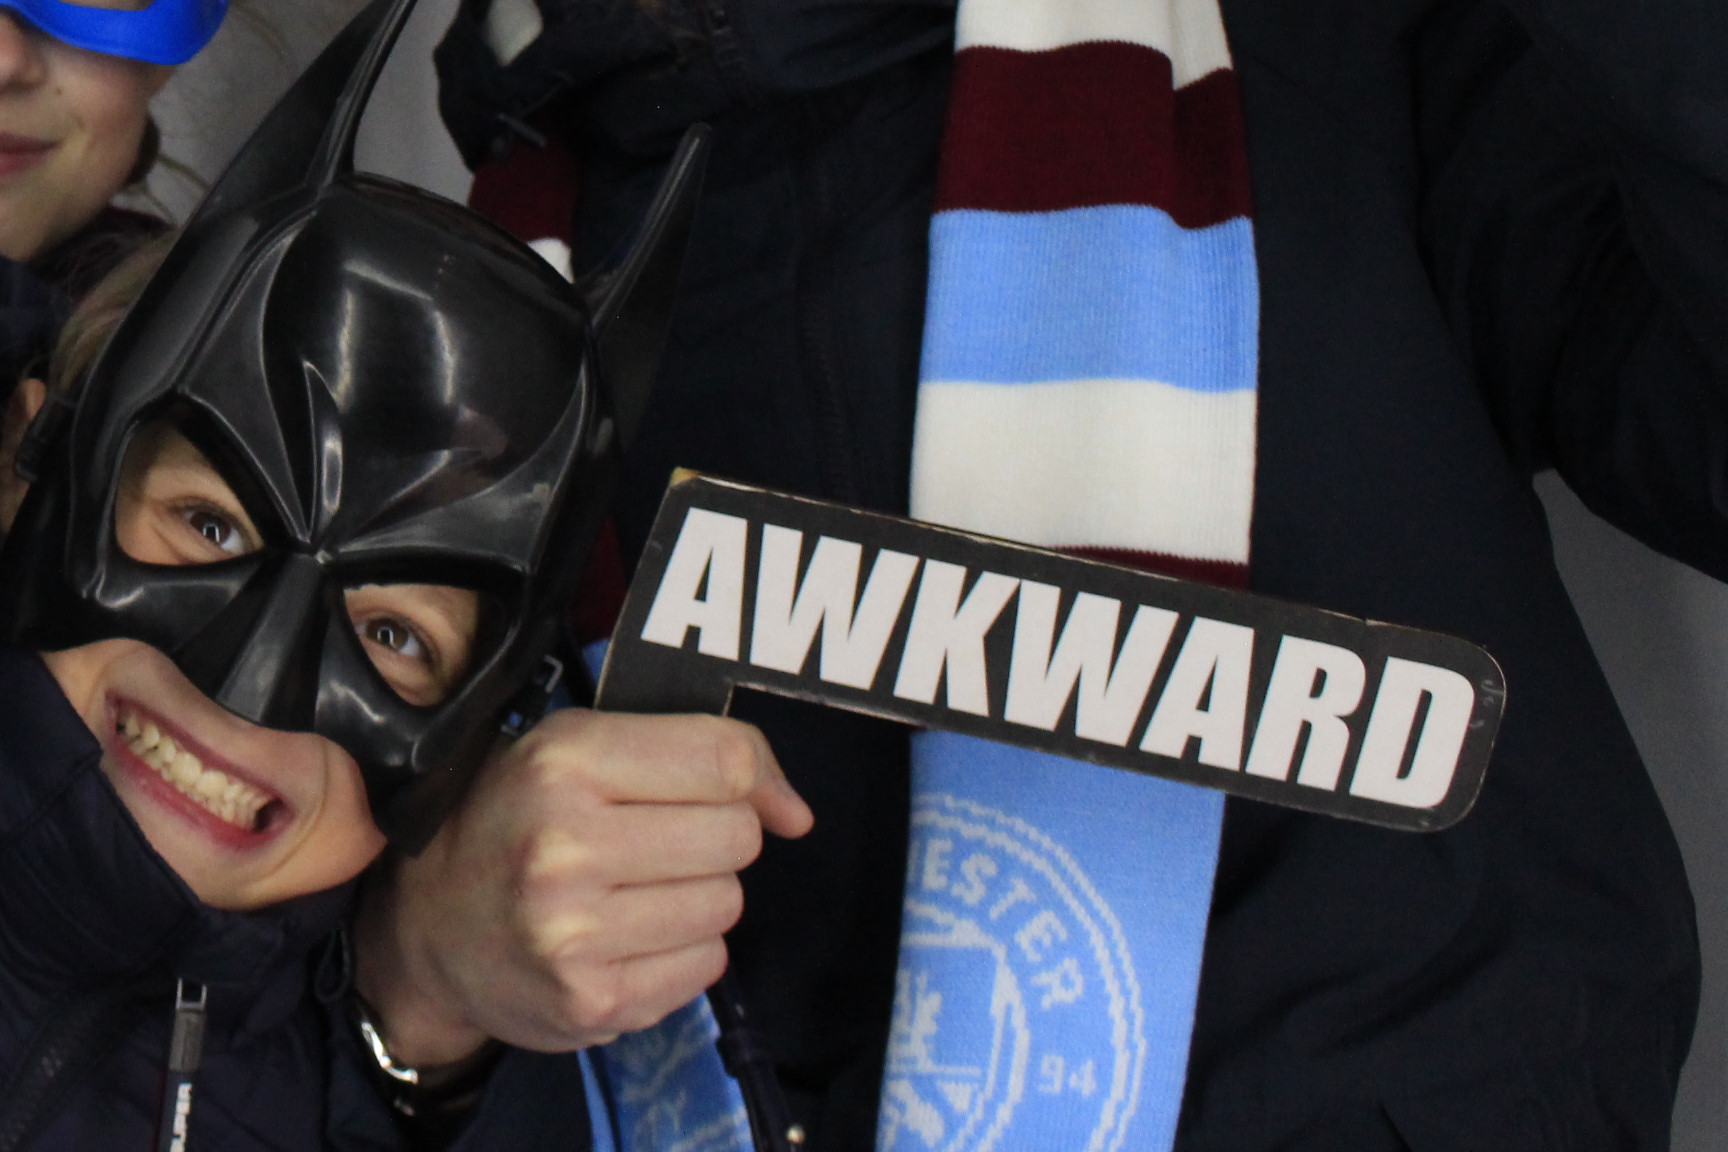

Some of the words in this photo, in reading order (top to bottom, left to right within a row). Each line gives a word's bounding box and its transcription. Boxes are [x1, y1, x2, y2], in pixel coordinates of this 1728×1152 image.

[640, 506, 1475, 810] AWKWARD
[908, 840, 1085, 1011] ESTER
[1037, 1054, 1098, 1098] 94
